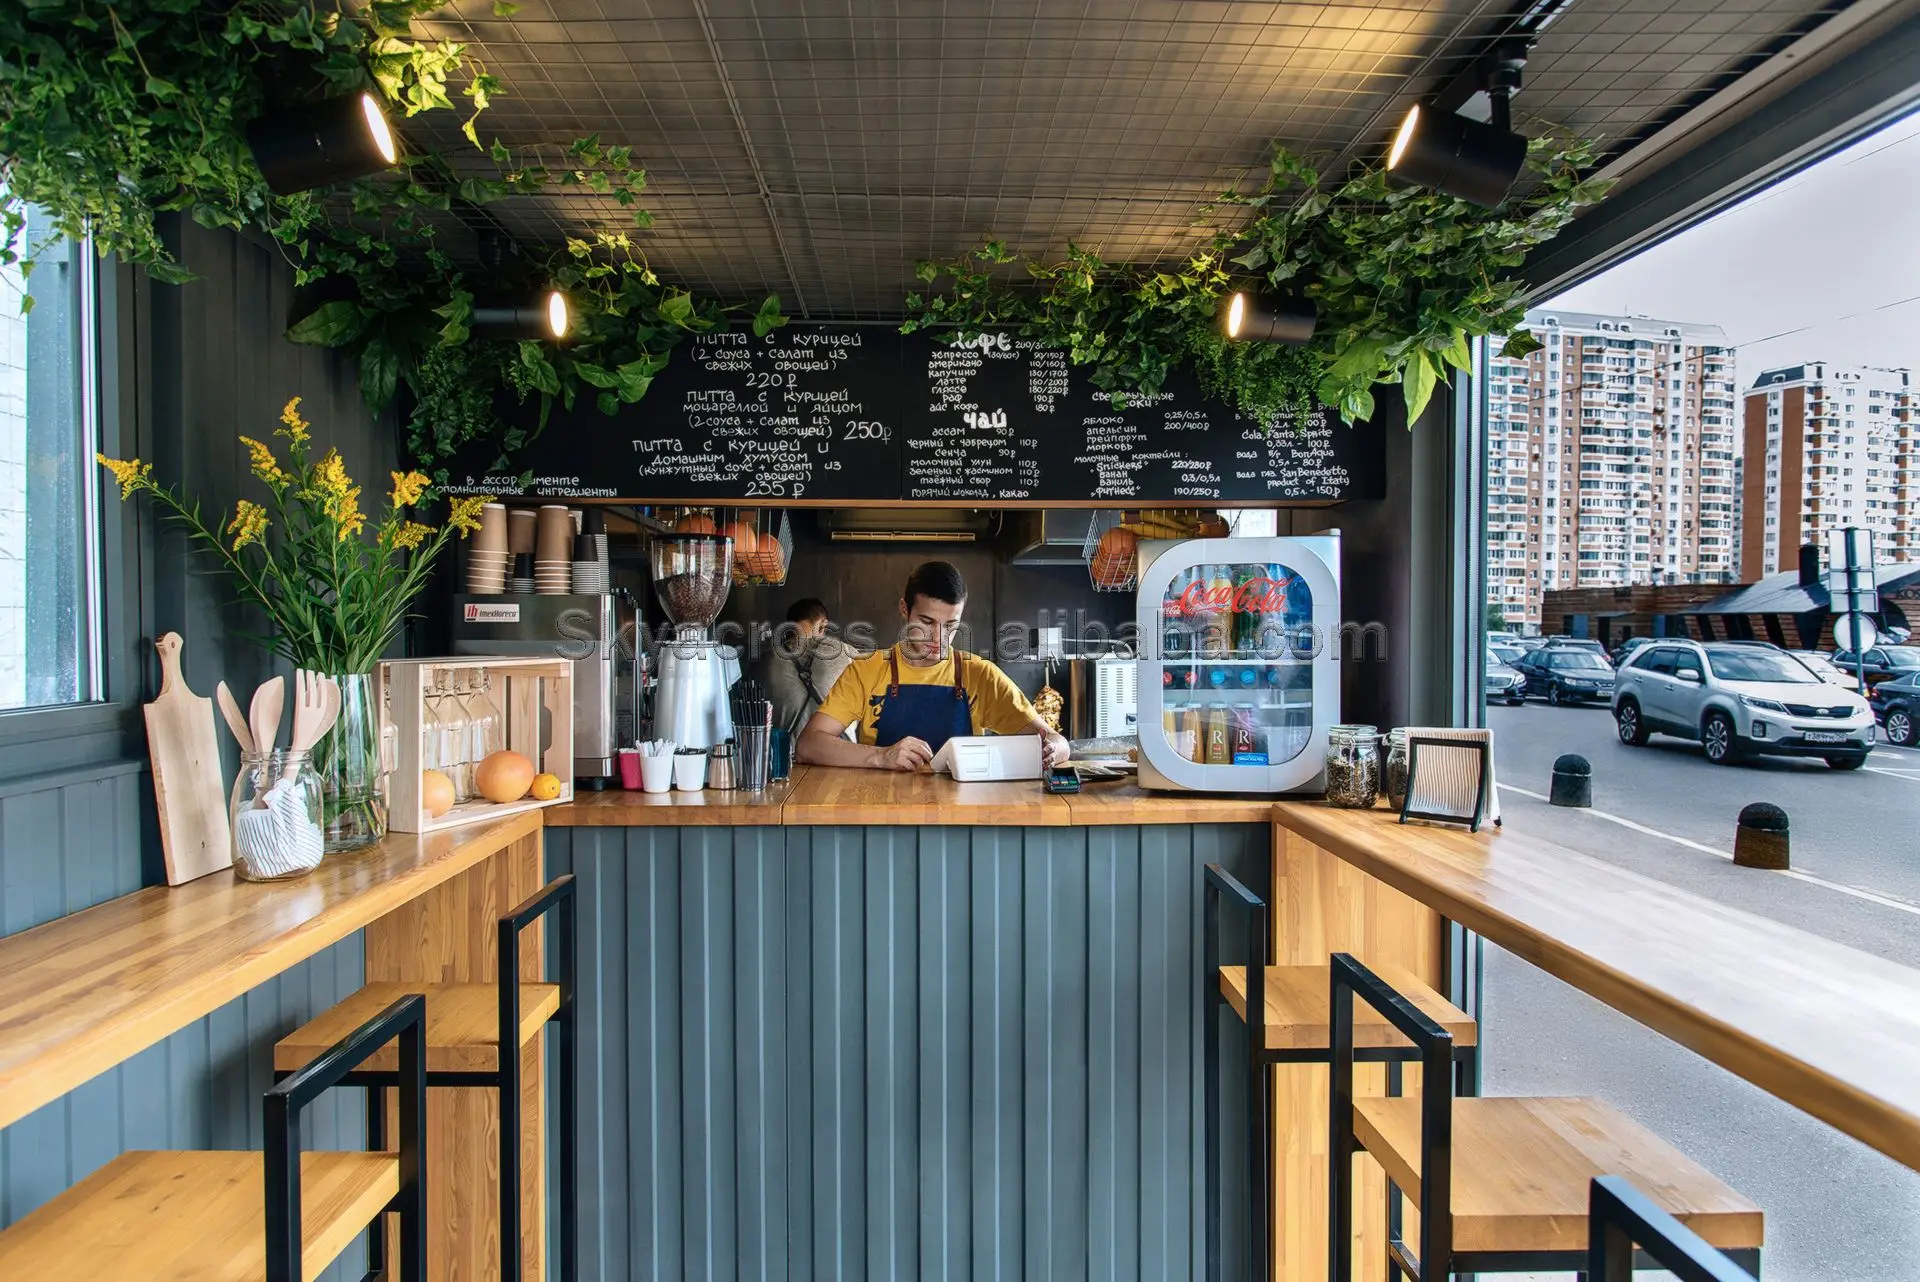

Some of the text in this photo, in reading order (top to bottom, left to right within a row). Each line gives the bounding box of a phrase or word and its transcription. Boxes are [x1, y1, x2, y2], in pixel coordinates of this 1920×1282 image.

[793, 332, 862, 347] курицей
[715, 350, 750, 360] соуса
[768, 349, 814, 360] салат
[829, 350, 848, 360] из
[931, 351, 979, 361] эспрессо
[705, 361, 753, 372] свежих
[928, 369, 977, 379] капучино
[746, 372, 783, 389] 220
[687, 390, 736, 403] питта
[783, 388, 848, 404] курицей
[683, 401, 769, 415] моцареллой
[759, 416, 800, 426] салат
[812, 416, 831, 426] из
[711, 427, 759, 437] свежих
[632, 439, 684, 453] питта
[728, 439, 801, 454] курицей
[651, 454, 725, 467] домашним
[772, 462, 813, 472] салат
[824, 462, 843, 471] из
[690, 472, 739, 483] свежих
[744, 481, 785, 497] 235
